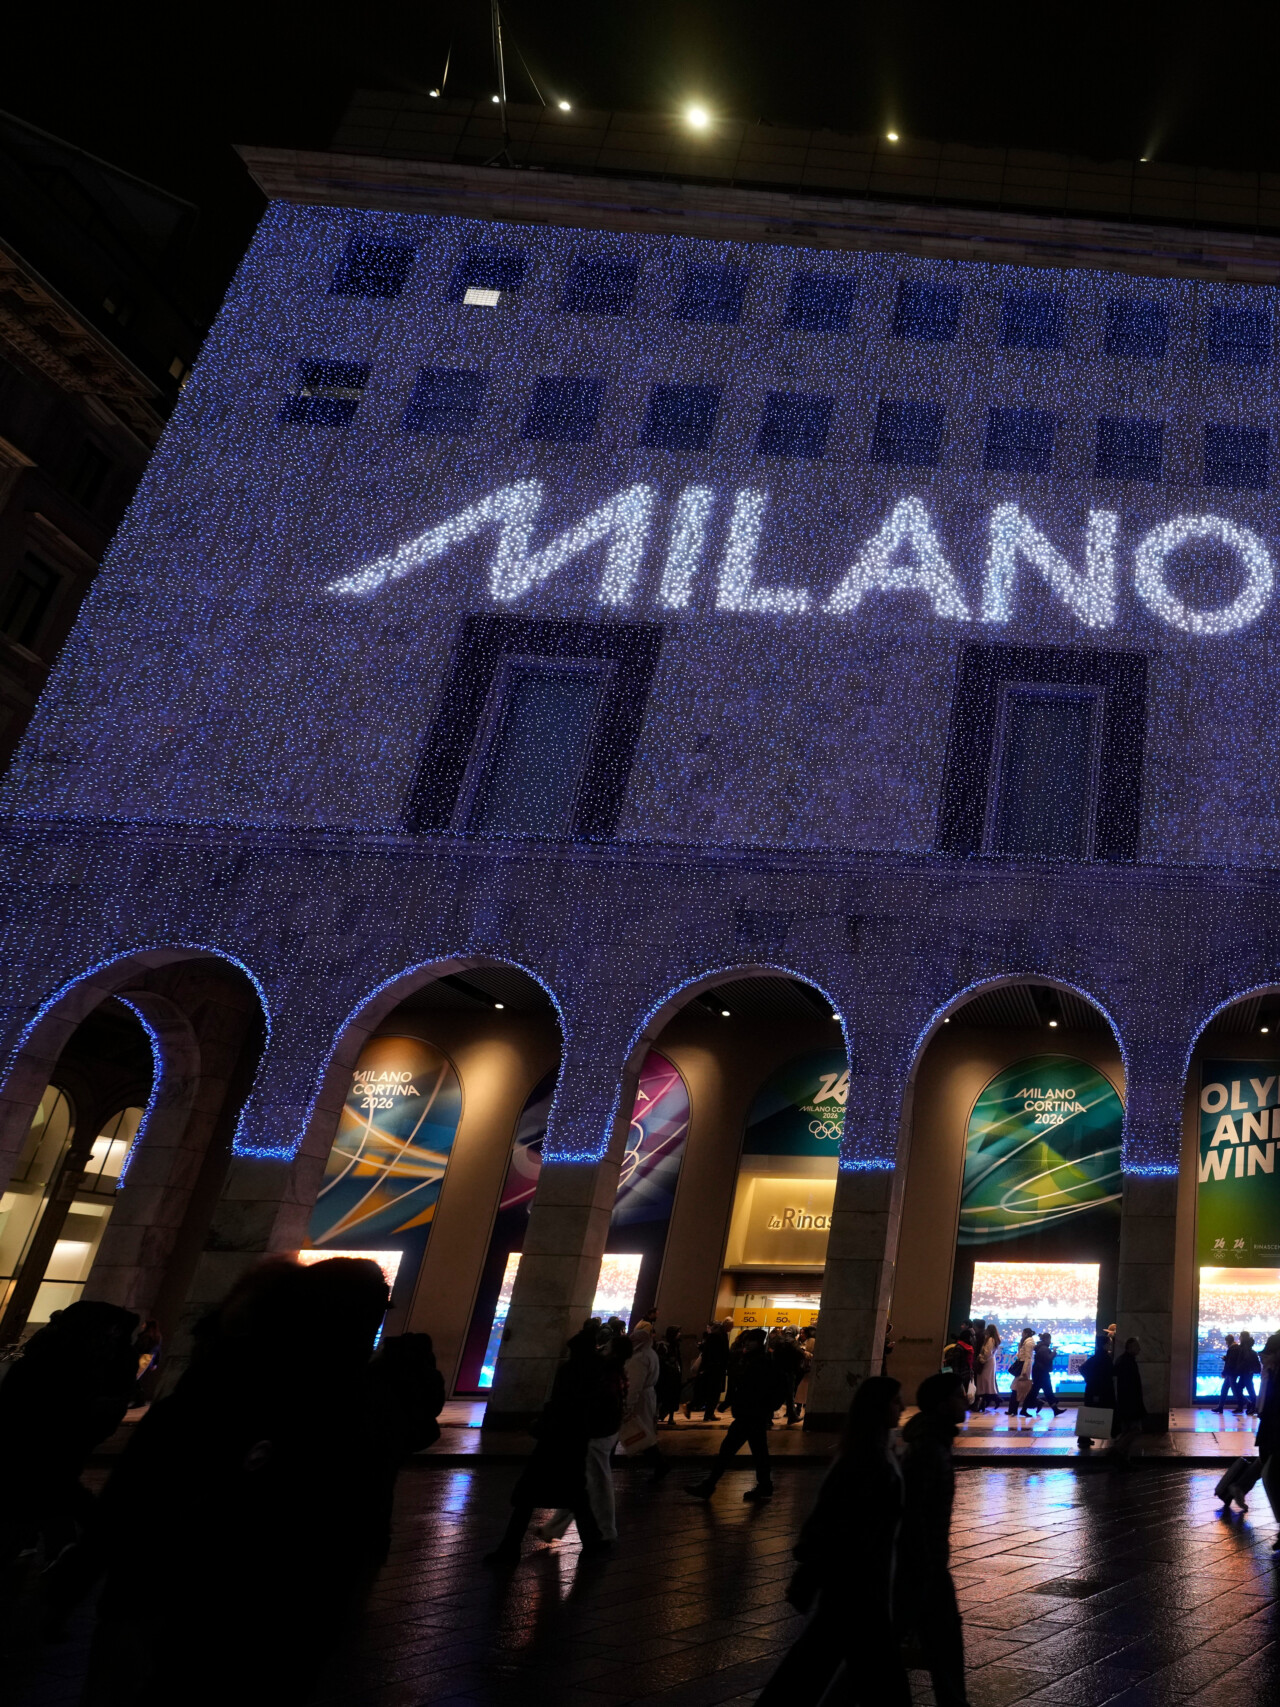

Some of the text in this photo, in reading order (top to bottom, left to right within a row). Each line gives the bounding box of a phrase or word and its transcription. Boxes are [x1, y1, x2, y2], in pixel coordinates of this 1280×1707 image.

[326, 478, 1275, 636] MILANO
[352, 1070, 413, 1083] MILANO
[352, 1083, 421, 1097] CORTINA
[1014, 1087, 1076, 1100] MILANO
[360, 1097, 394, 1109] 2026
[798, 1105, 831, 1113] MILANO
[1024, 1100, 1087, 1113] CORTINA
[1034, 1113, 1065, 1125] 2026
